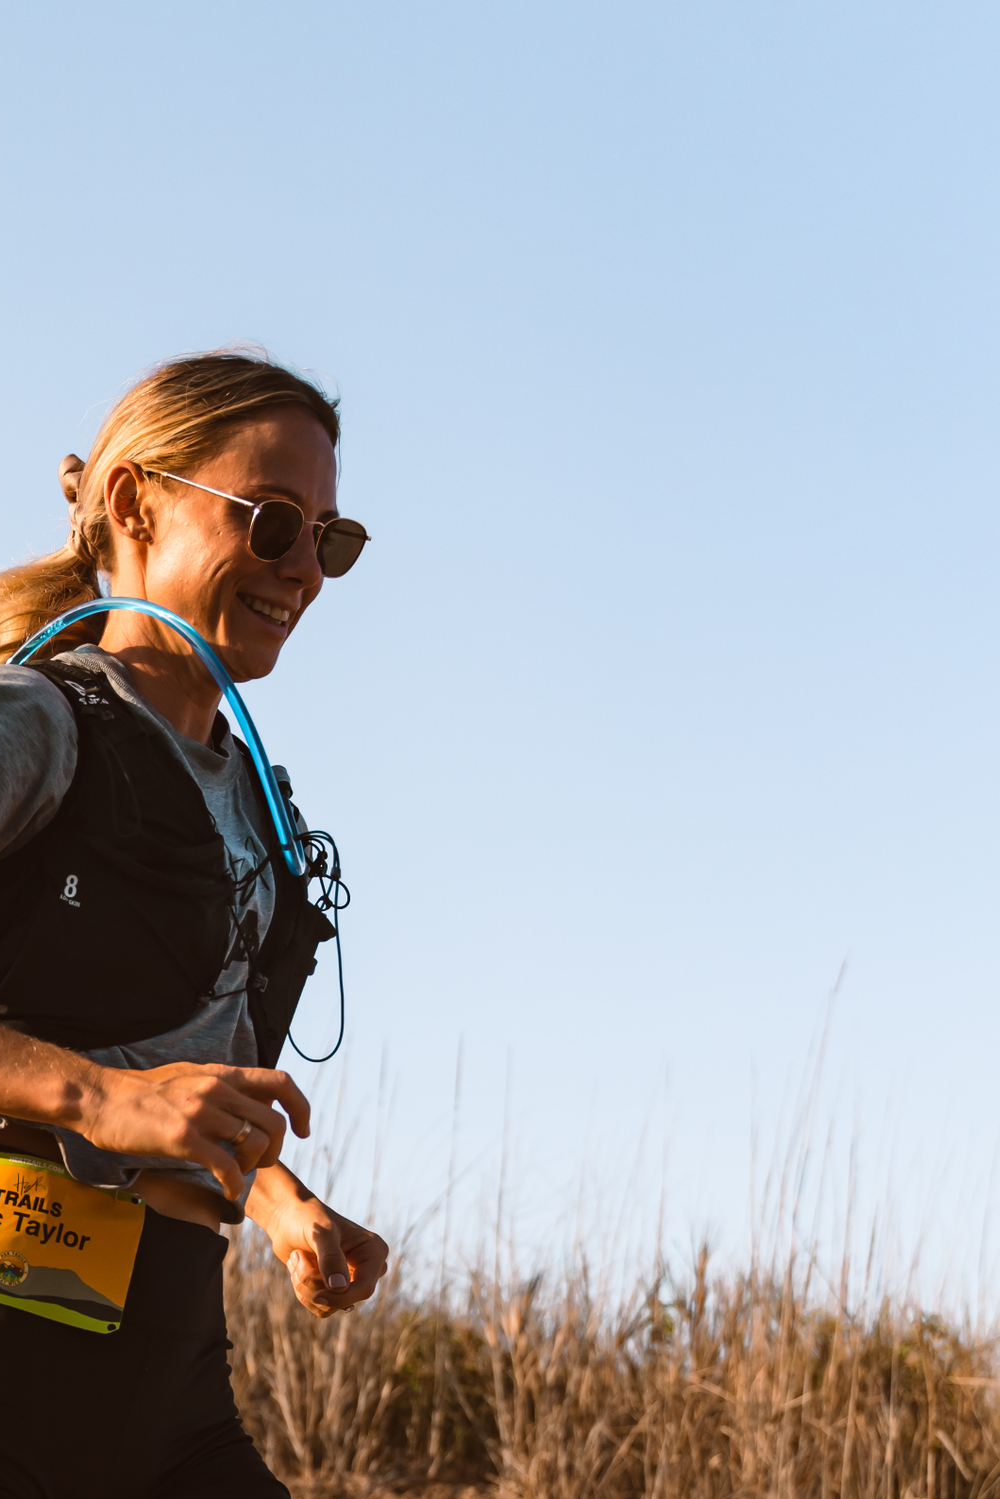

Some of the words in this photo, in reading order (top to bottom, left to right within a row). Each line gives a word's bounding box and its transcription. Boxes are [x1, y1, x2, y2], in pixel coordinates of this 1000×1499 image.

[64, 874, 79, 898] 8
[9, 1156, 65, 1175] HERTRAILS.COM
[13, 1211, 91, 1251] Taylor
